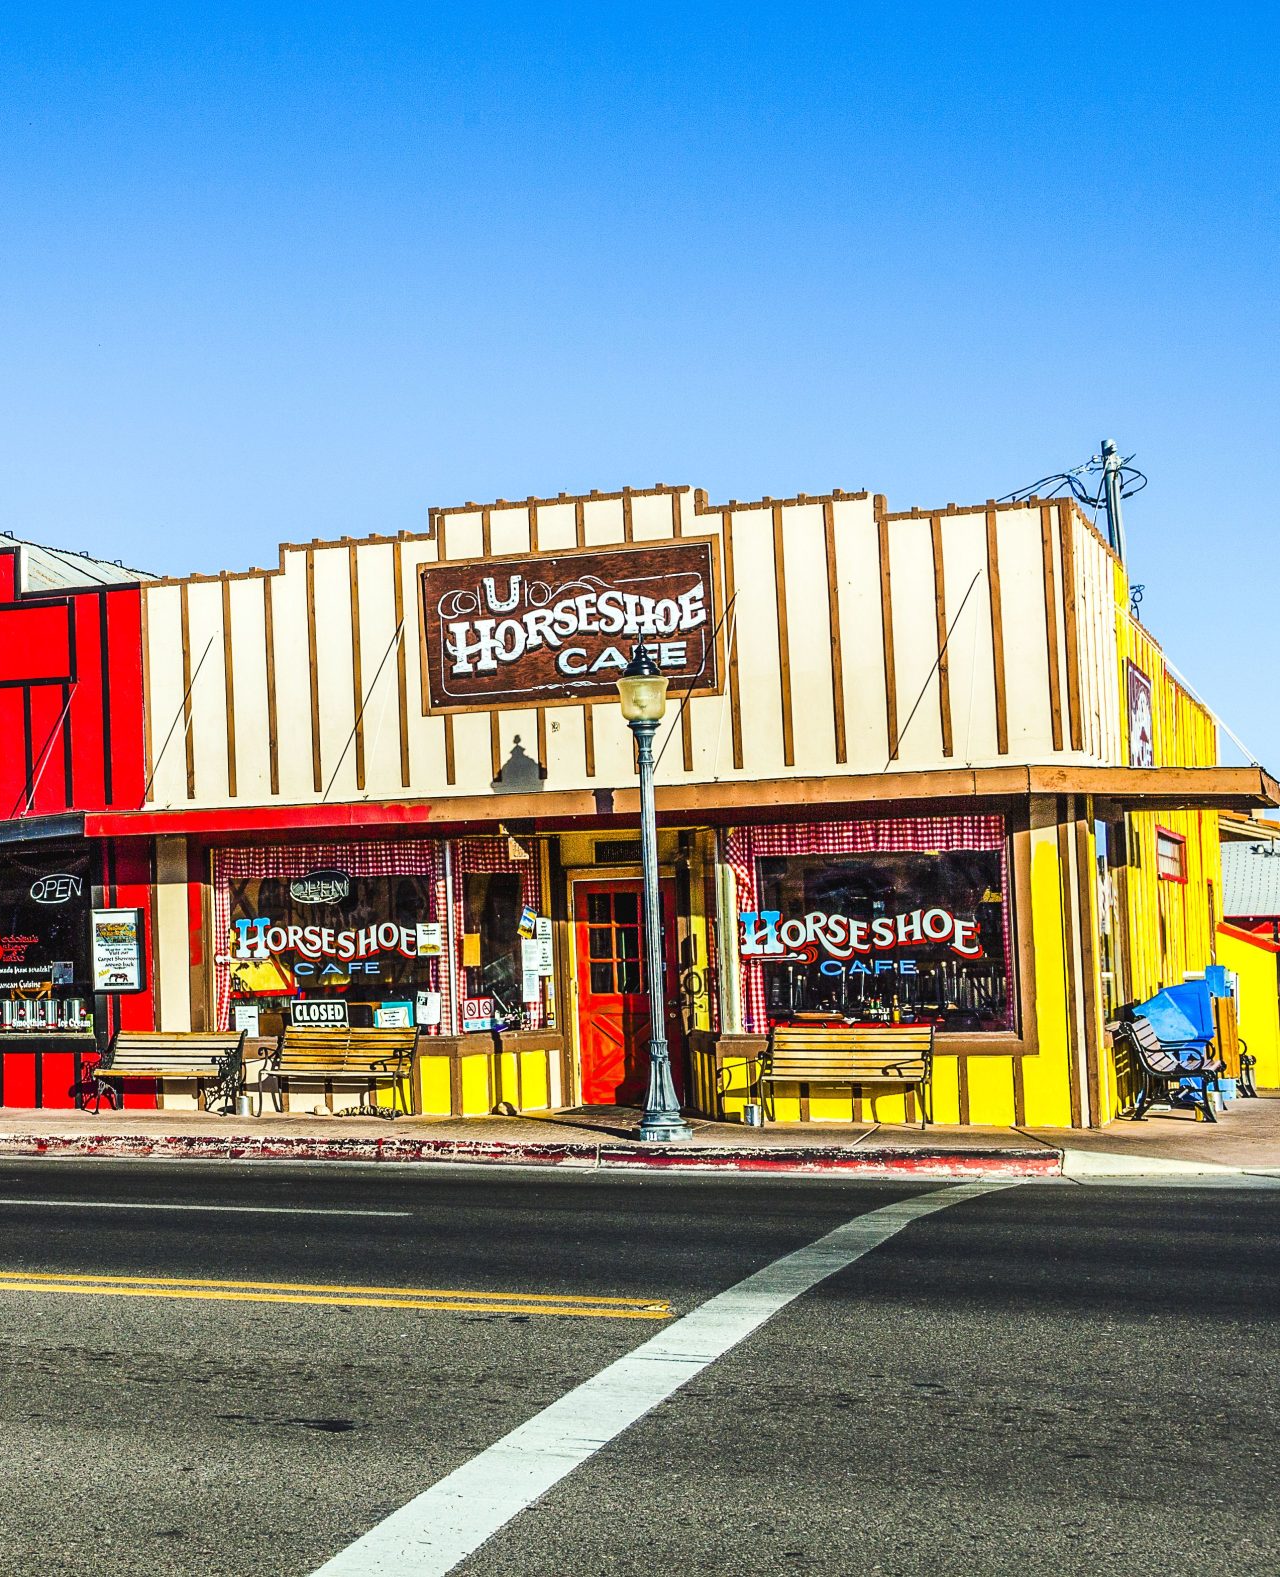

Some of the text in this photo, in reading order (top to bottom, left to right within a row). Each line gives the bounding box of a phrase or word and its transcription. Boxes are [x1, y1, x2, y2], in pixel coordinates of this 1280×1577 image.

[446, 580, 707, 676] HORSESHOE
[30, 878, 83, 899] OPEN
[235, 917, 417, 962] HORSESHOE
[739, 909, 984, 960] HORSESHOE
[294, 962, 380, 975] CAFE
[820, 960, 917, 976] CAFE
[19, 980, 41, 989] Cuisine
[295, 1004, 344, 1021] CLOSED
[58, 1018, 68, 1028] Ice
[69, 1018, 91, 1028] Cream
